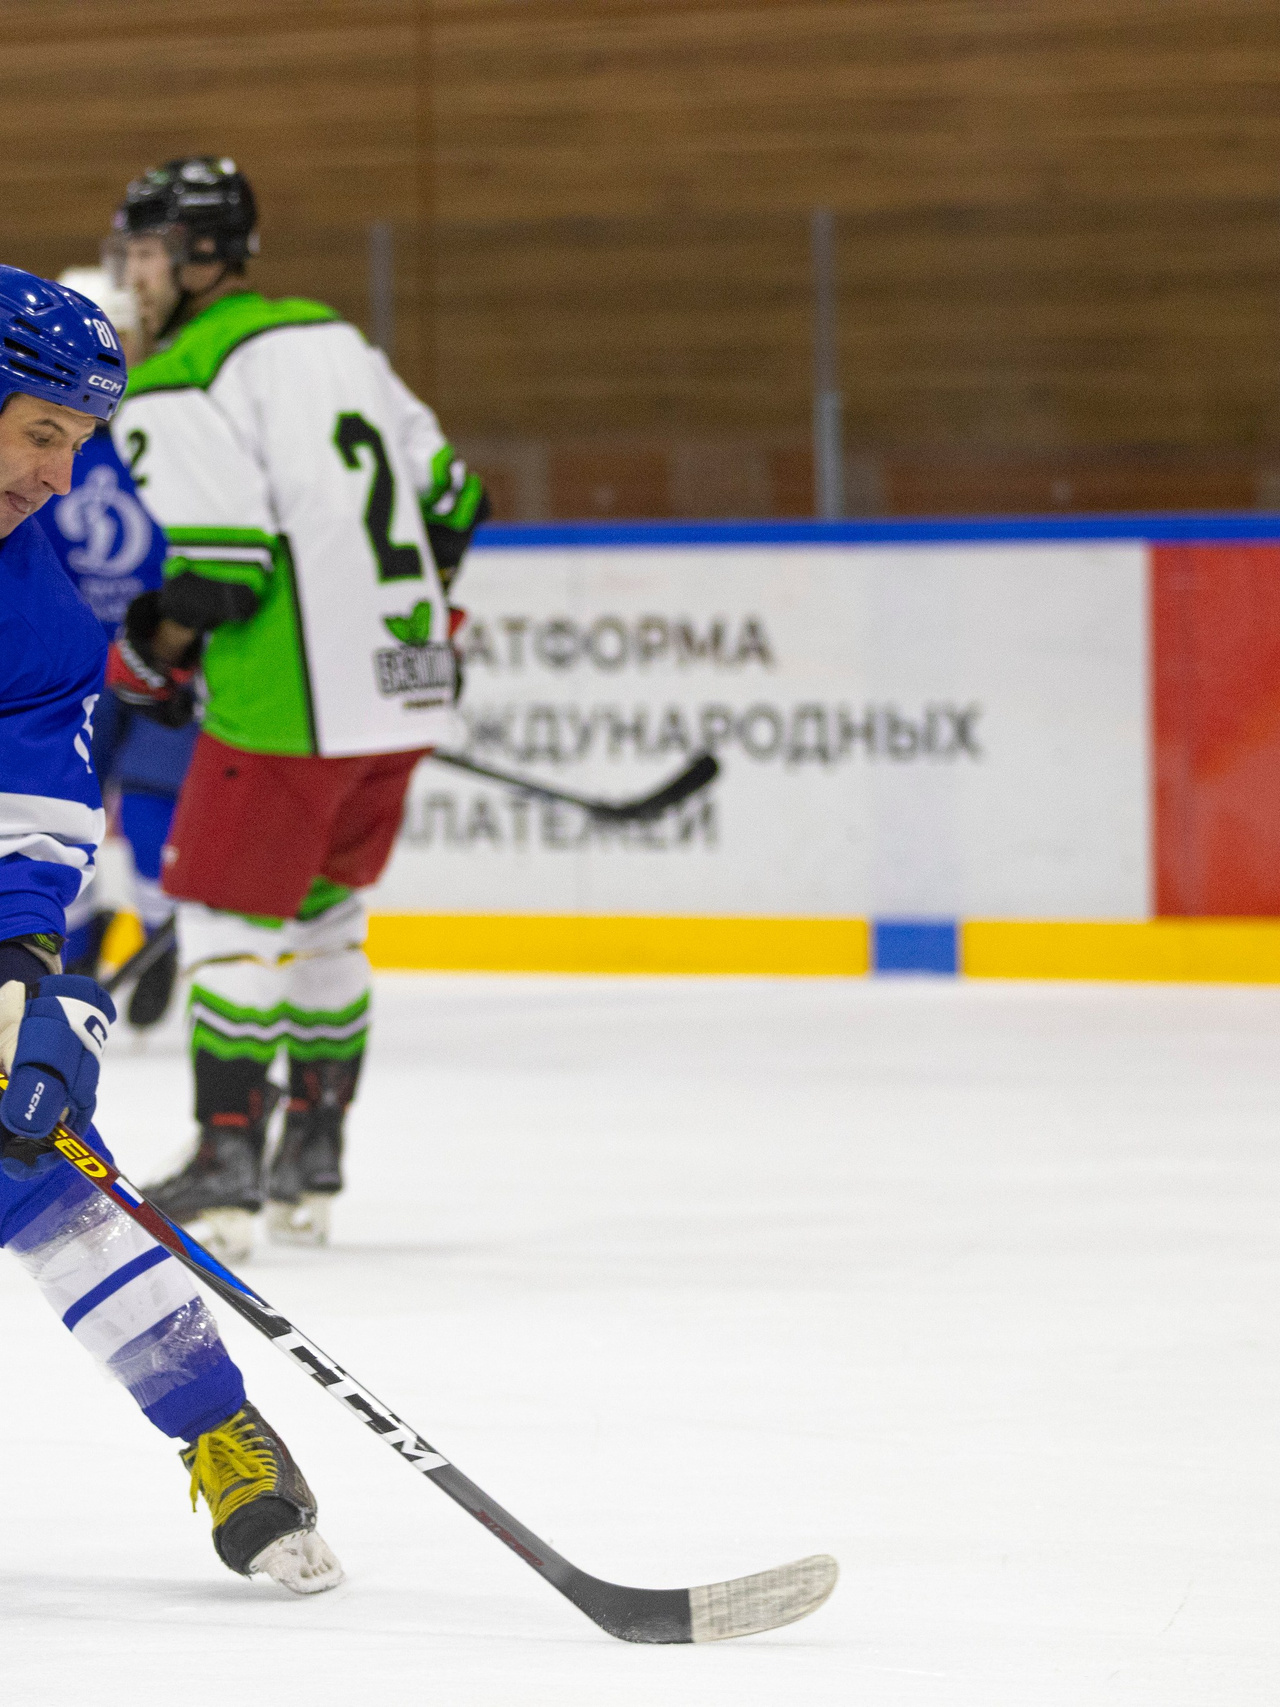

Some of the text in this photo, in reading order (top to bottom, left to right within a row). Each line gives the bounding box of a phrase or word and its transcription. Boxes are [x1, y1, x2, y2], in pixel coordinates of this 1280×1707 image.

[93, 318, 118, 351] 81
[88, 374, 122, 394] CCM
[333, 411, 422, 584] 2
[24, 1082, 45, 1121] CCM
[271, 1325, 452, 1473] CCM
